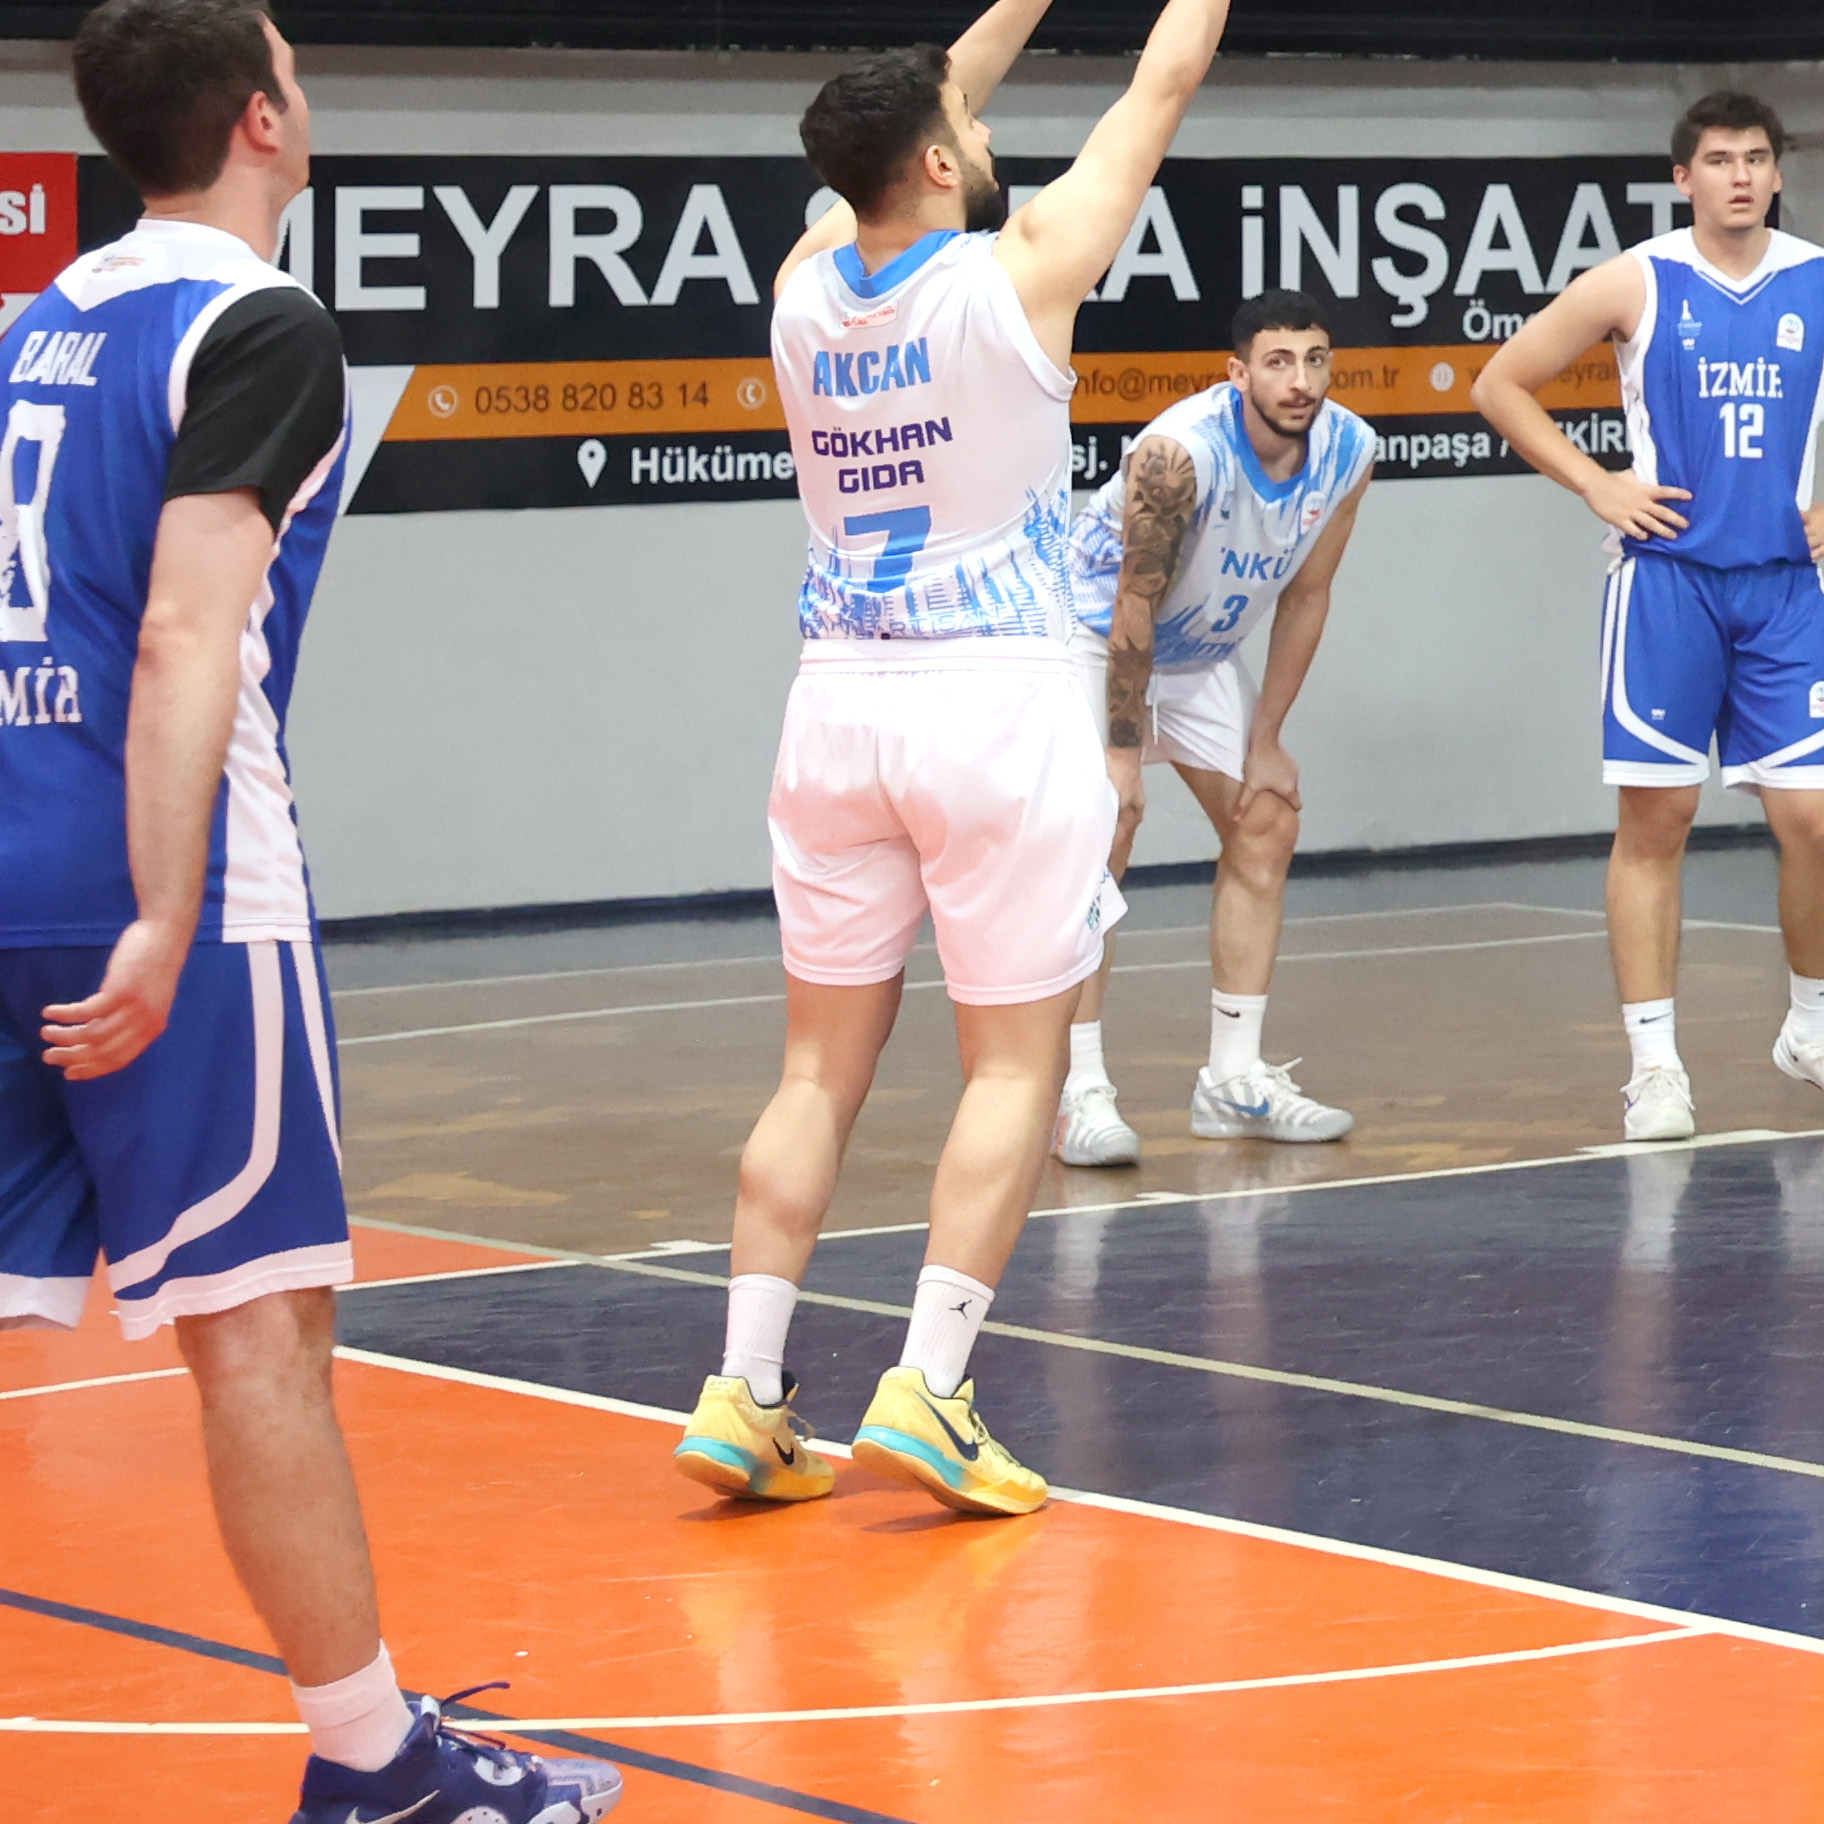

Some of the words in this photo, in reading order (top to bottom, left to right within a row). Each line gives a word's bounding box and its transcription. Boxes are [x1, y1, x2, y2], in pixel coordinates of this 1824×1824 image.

[0, 182, 47, 236] Sİ
[1462, 298, 1538, 342] Öm
[812, 336, 933, 398] AKCAN
[474, 384, 551, 414] 0538
[560, 382, 618, 413] 820
[626, 380, 665, 411] 83
[678, 379, 711, 409] 14
[811, 416, 954, 459] GÖKHAN
[1718, 401, 1765, 459] 12
[630, 444, 797, 485] Hüküme
[837, 459, 926, 495] GIDA
[843, 504, 932, 595] 7
[1210, 594, 1249, 634] 3
